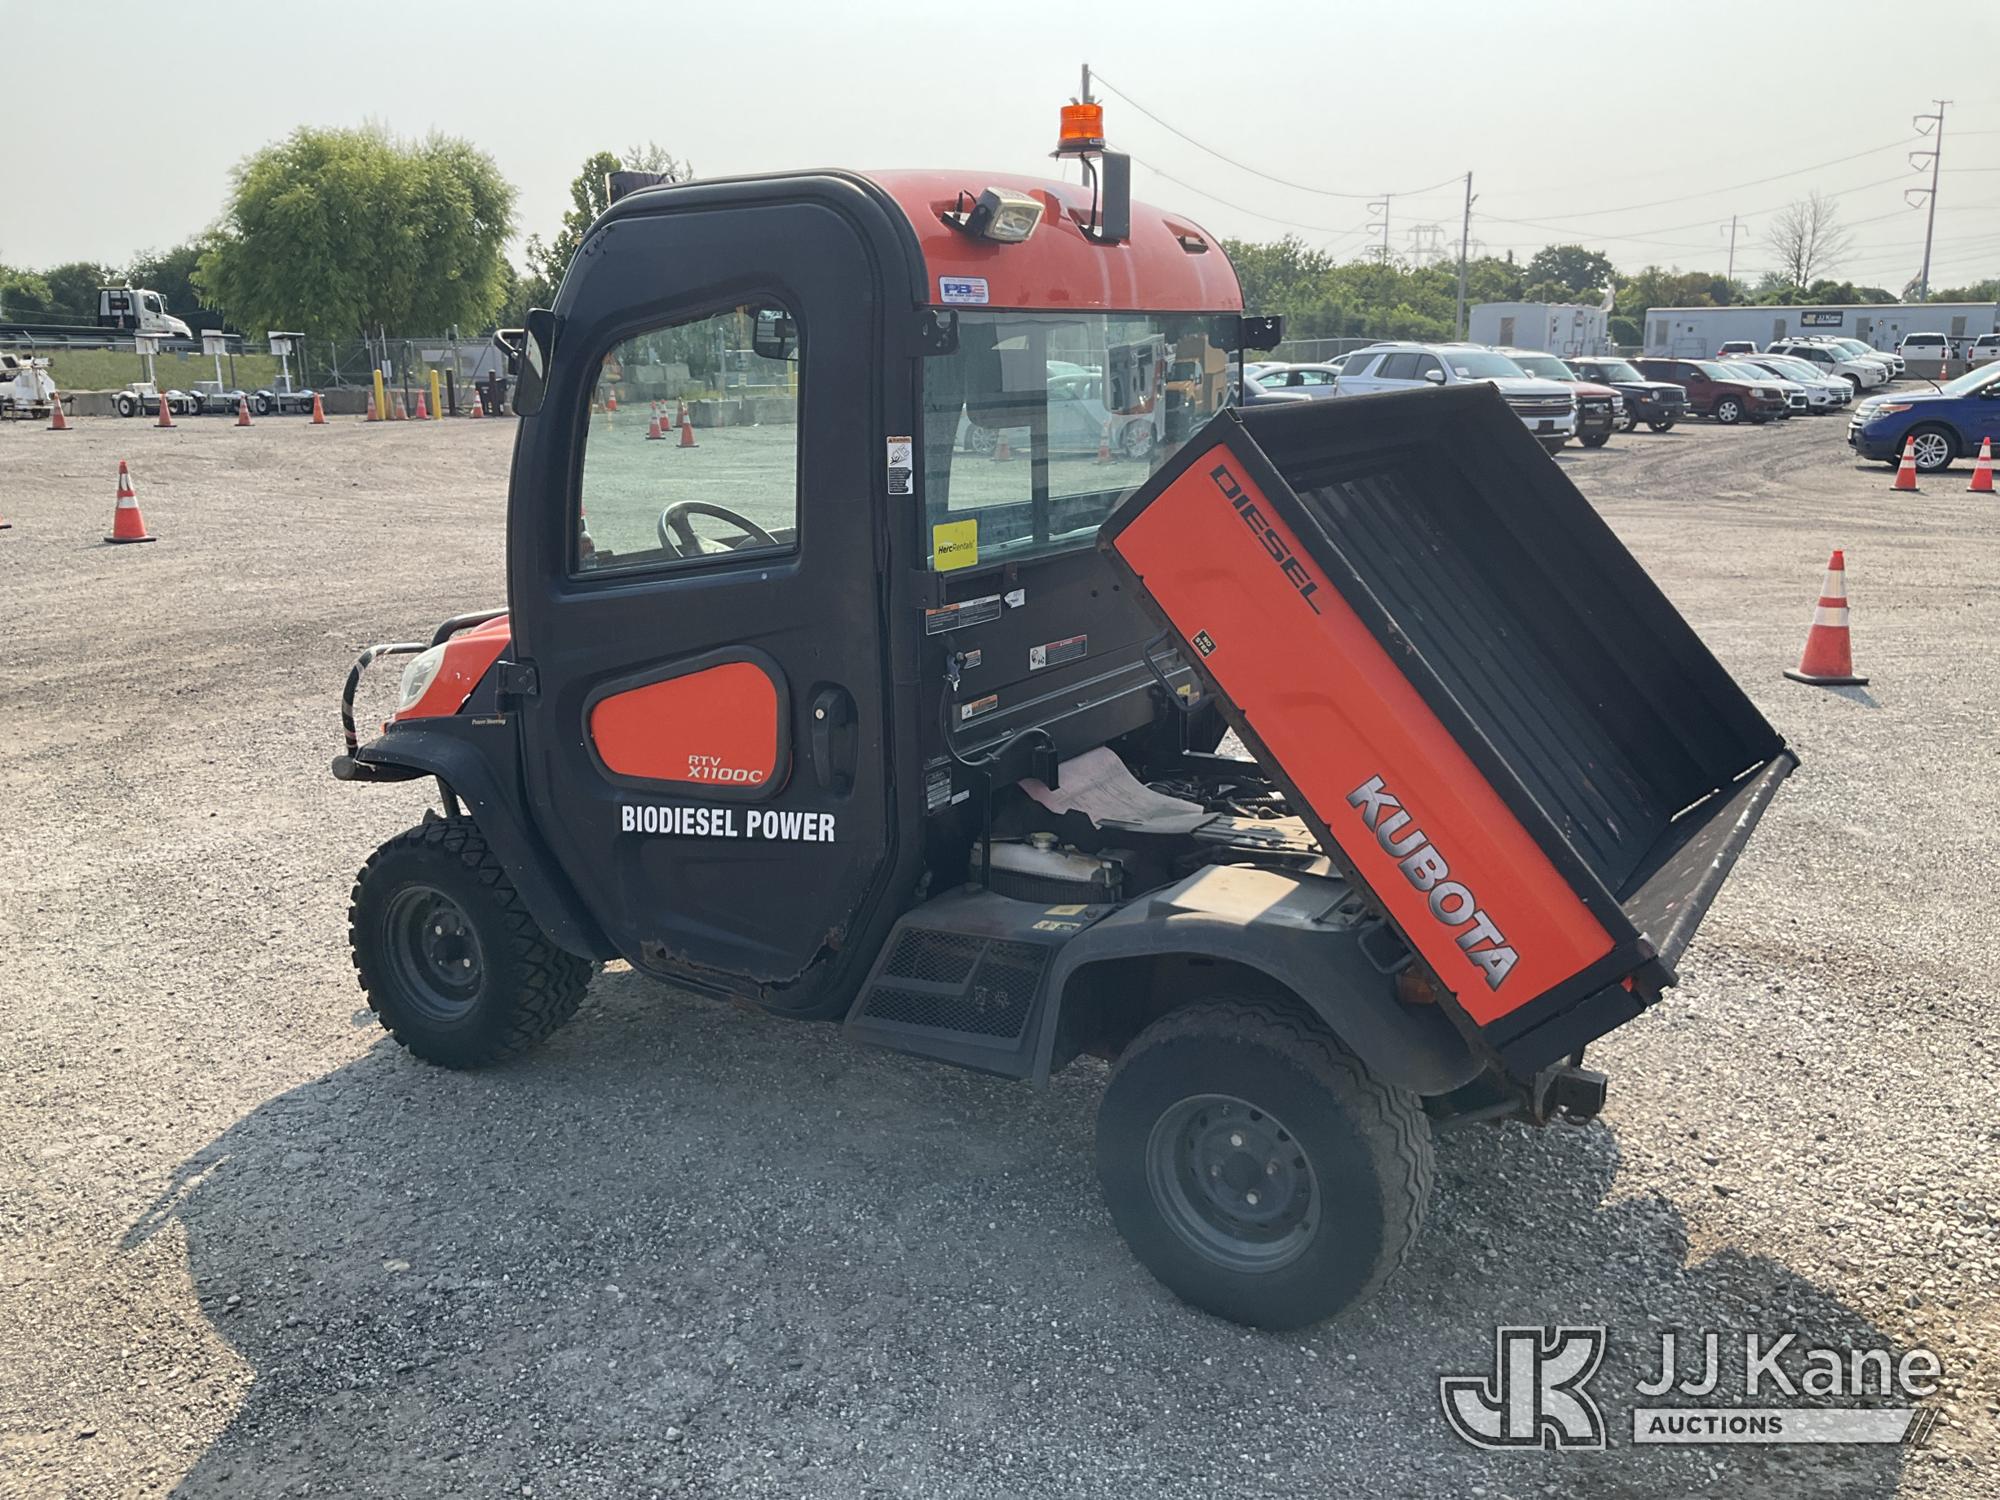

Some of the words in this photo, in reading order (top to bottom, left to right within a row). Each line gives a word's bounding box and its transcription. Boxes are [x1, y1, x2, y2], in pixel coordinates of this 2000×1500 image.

[1210, 464, 1321, 615] DIESEL
[1195, 636, 1210, 653] STEP
[1202, 636, 1212, 647] NO
[688, 755, 721, 767] RTV
[687, 766, 763, 783] X1100C
[622, 805, 738, 837] BIODIESEL
[746, 810, 836, 842] POWER
[1346, 773, 1520, 992] KUBOTA
